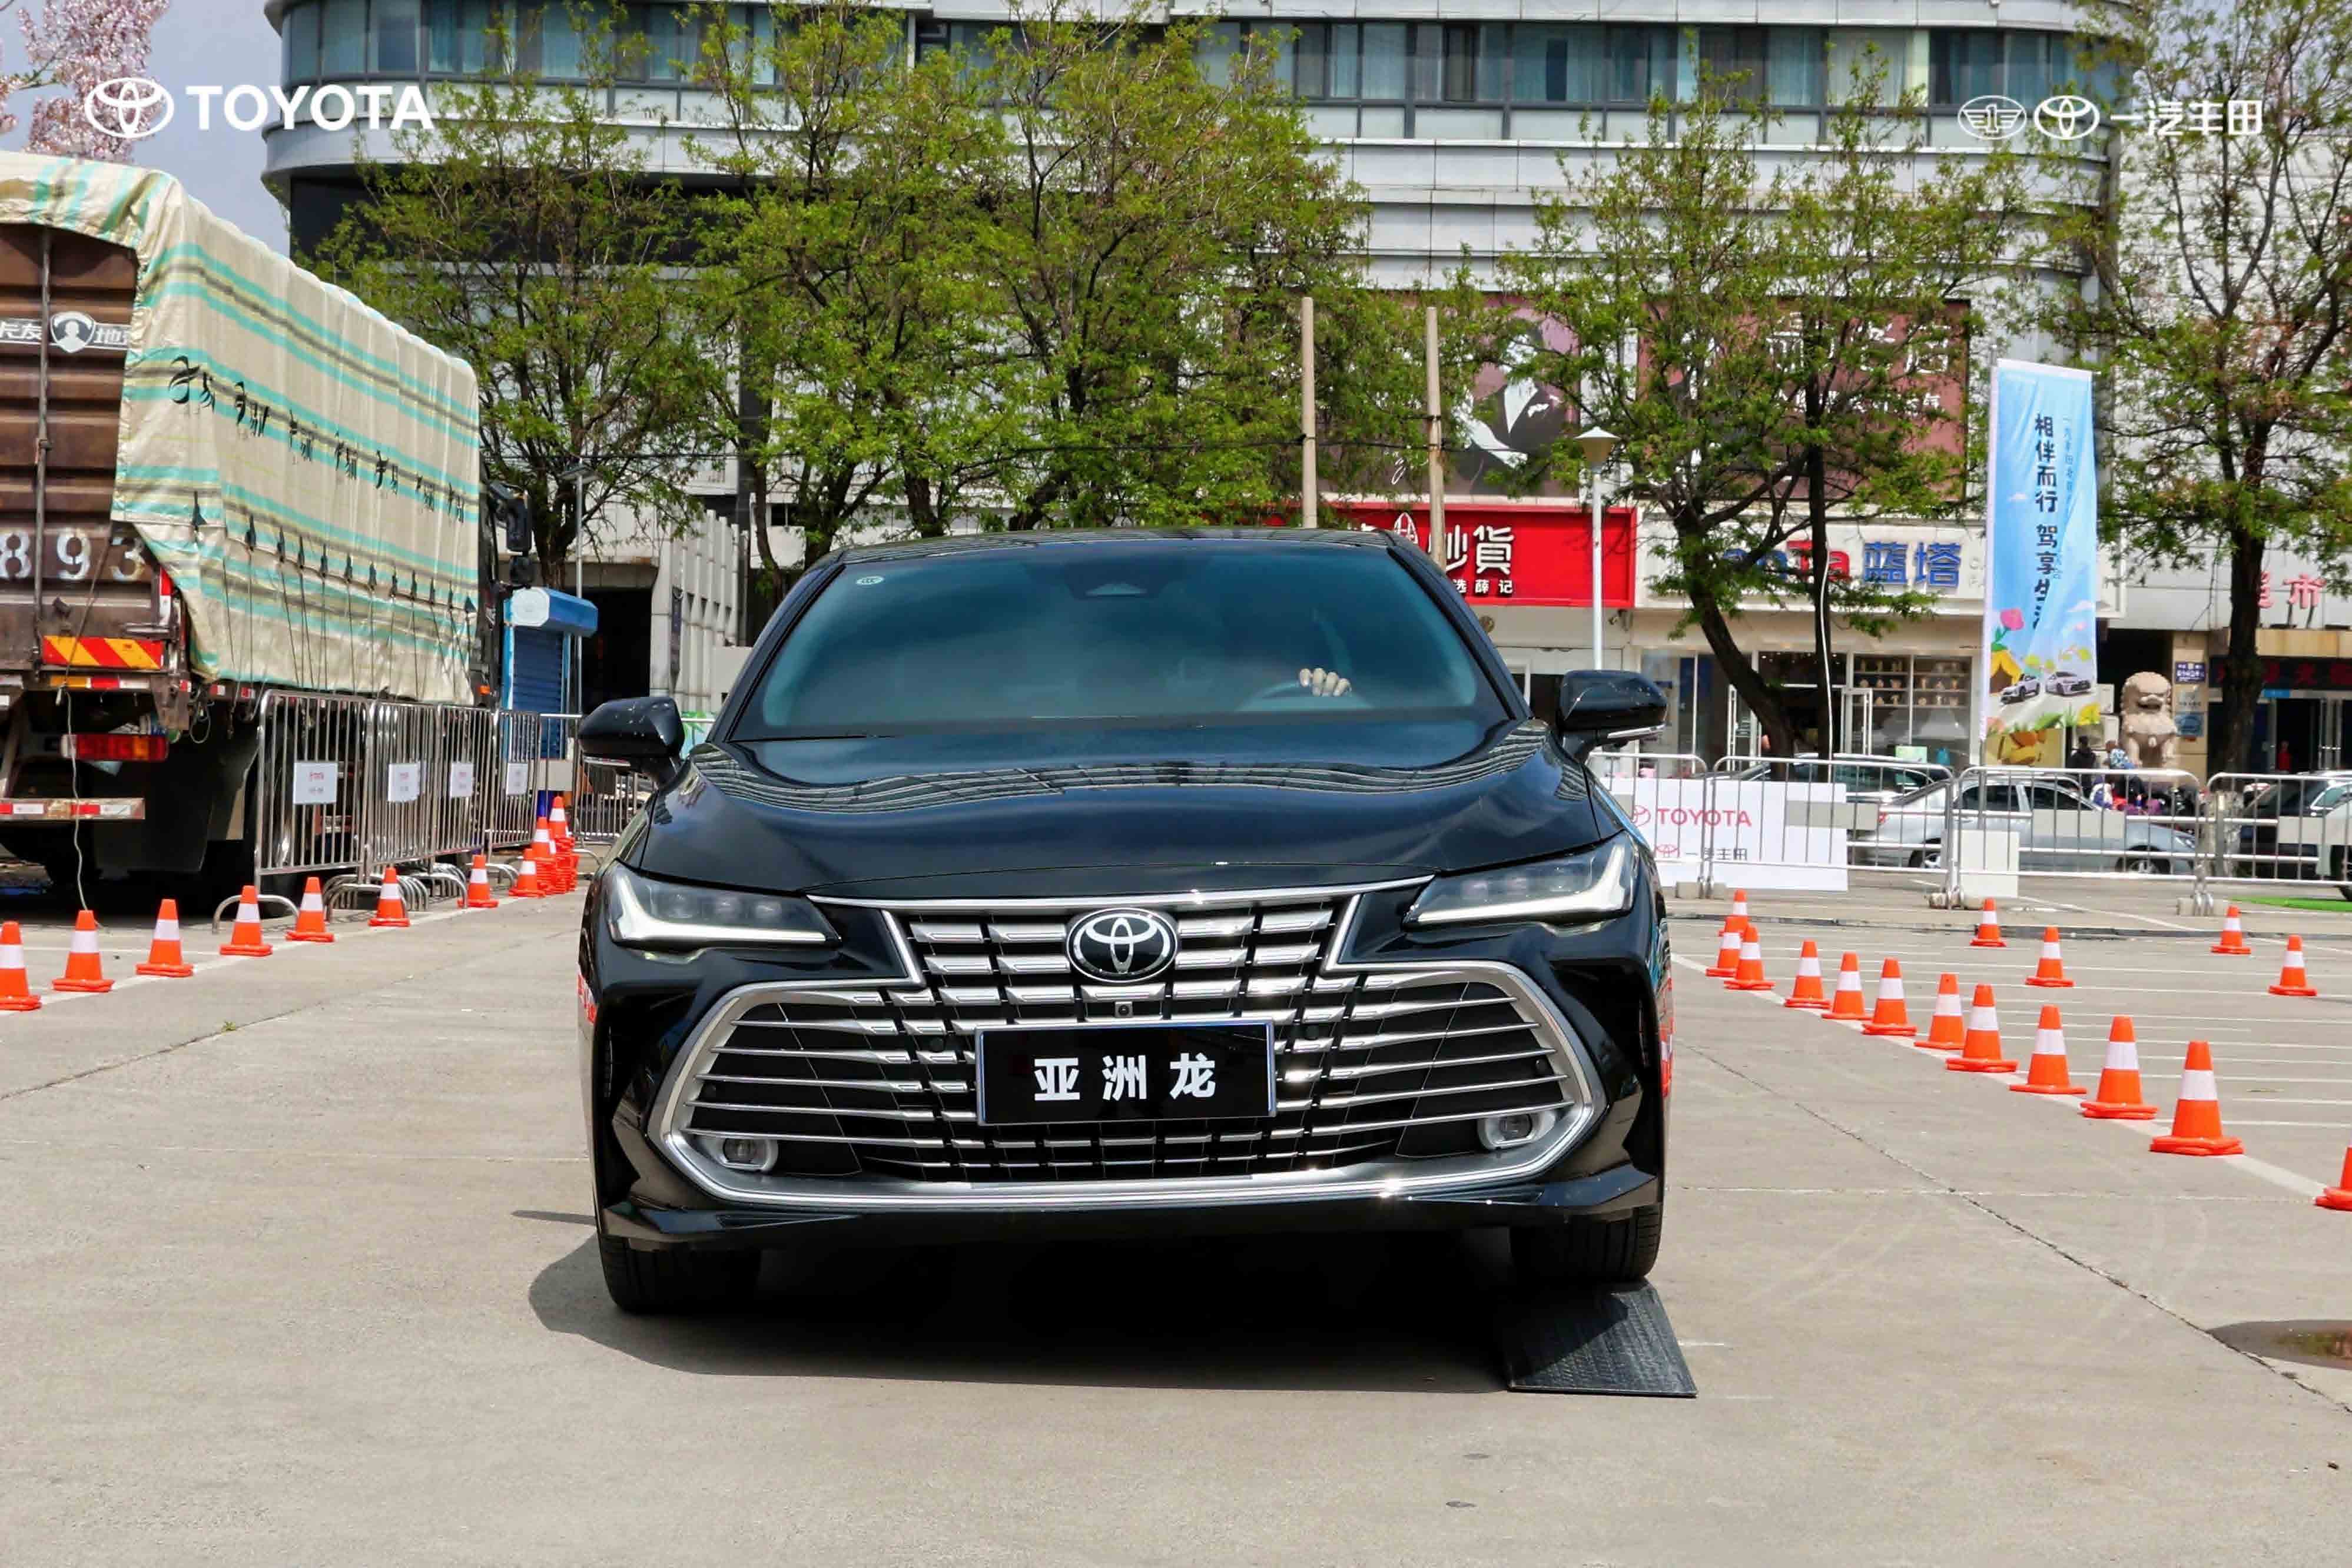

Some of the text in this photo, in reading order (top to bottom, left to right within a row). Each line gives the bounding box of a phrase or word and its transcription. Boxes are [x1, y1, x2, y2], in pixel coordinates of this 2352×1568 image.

[2032, 413, 2058, 629] 相伴而行 驾享生
[1863, 541, 1962, 588] 蓝塔
[1657, 809, 1752, 828] TOYOTA
[1033, 1053, 1217, 1102] 亚洲龙
